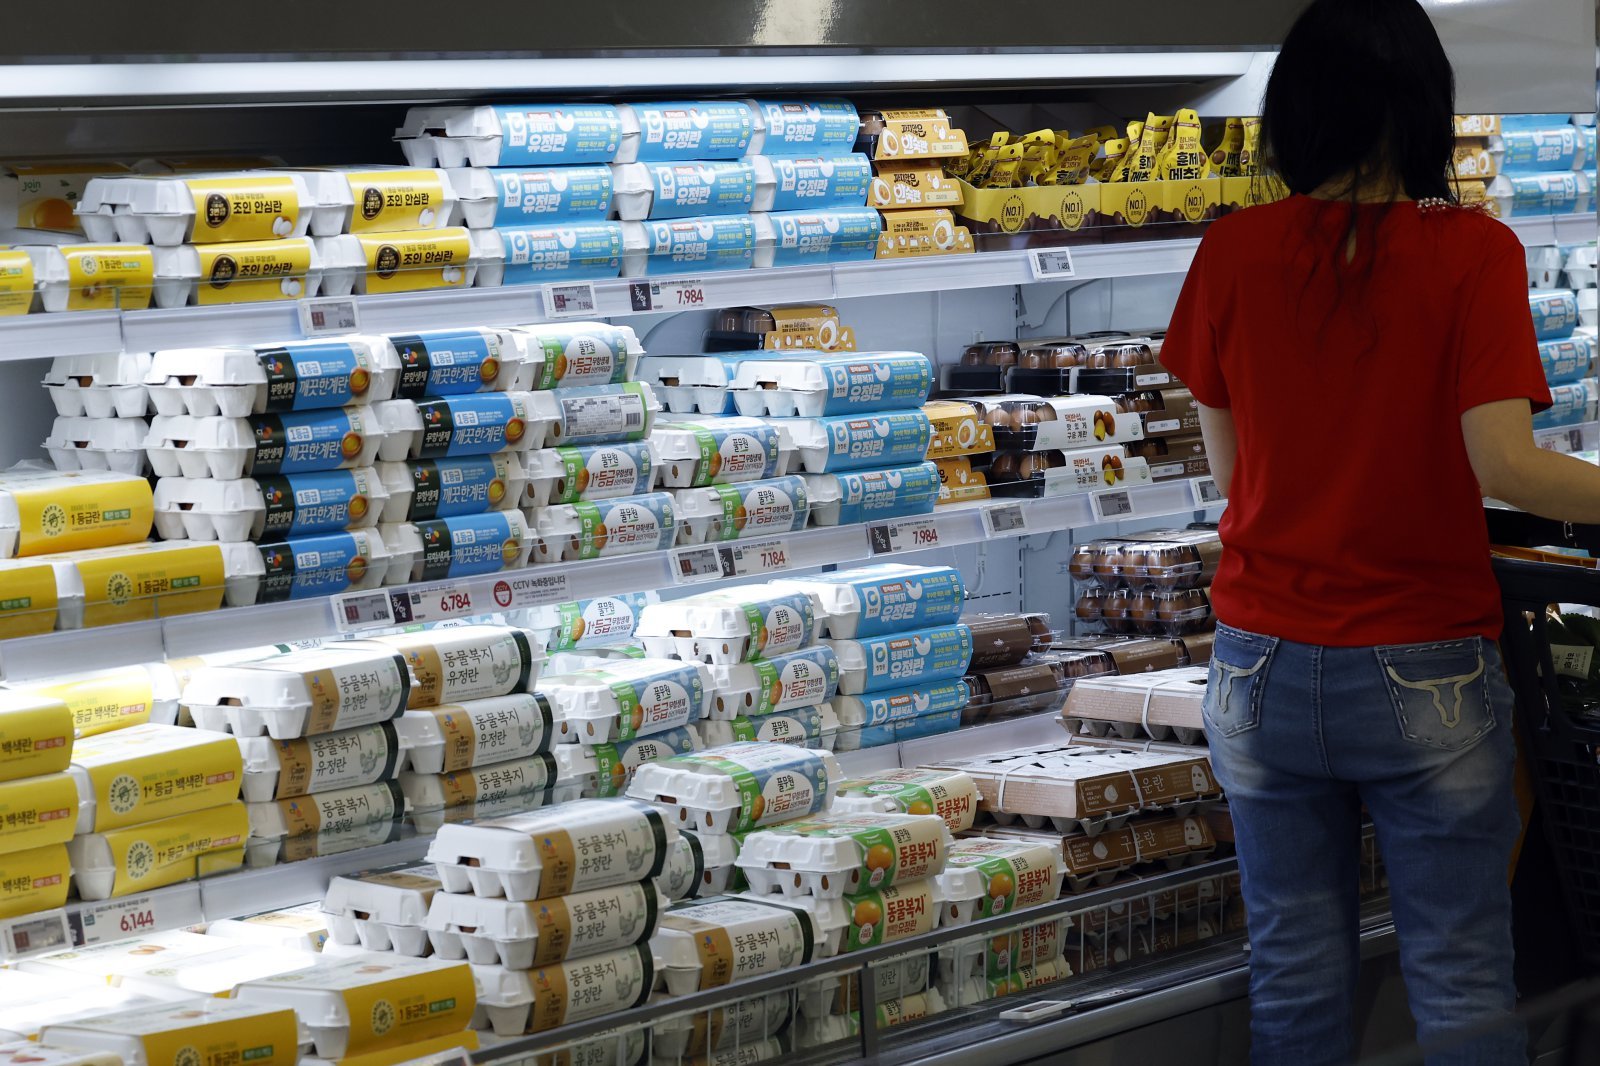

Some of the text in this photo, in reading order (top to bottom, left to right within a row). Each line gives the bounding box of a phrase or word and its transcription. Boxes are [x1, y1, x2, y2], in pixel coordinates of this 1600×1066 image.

[664, 131, 701, 148] 유정란
[784, 125, 816, 142] 유정란
[527, 134, 567, 152] 유정란
[676, 187, 710, 204] 유정란
[796, 180, 828, 197] 유정란
[233, 200, 282, 214] 조인 안심란
[386, 193, 429, 206] 조인 안심란
[523, 195, 561, 212] 유정란
[1065, 202, 1080, 212] NO.1
[1130, 200, 1143, 210] NO.1
[1188, 196, 1202, 206] NO.1
[1006, 206, 1020, 216] NO.1
[404, 251, 453, 265] 조인 안심란
[240, 263, 292, 276] 조인 안심란
[676, 289, 704, 304] 7,984
[578, 340, 595, 355] 풀무원
[433, 352, 452, 364] 1등급
[568, 357, 592, 374] 1+등급
[300, 364, 319, 374] 1등급
[403, 371, 427, 382] 무항생제
[431, 366, 479, 384] 깨끗한계란
[271, 382, 295, 395] 무항생제
[299, 376, 348, 396] 깨끗한계란
[849, 384, 884, 402] 유정란
[457, 412, 476, 424] 1등급
[290, 428, 310, 440] 1등급
[426, 431, 450, 443] 무항생제
[455, 426, 504, 445] 깨끗한계란
[257, 447, 283, 459] 무항생제
[288, 441, 340, 461] 깨끗한계란
[732, 438, 749, 452] 풀무원
[850, 441, 884, 458] 유정란
[601, 452, 618, 468] 풀무원
[723, 454, 746, 472] 1+등급
[444, 471, 462, 483] 1등급
[591, 470, 615, 488] 1+등급
[299, 492, 318, 504] 1등급
[416, 489, 439, 502] 무항생제
[443, 484, 488, 504] 깨끗한계란
[758, 490, 775, 505] 풀무원
[268, 511, 292, 523] 무항생제
[297, 503, 348, 525] 깨끗한계란
[620, 507, 638, 523] 풀무원
[749, 507, 772, 524] 1+등급
[455, 531, 474, 544] 1등급
[610, 524, 636, 543] 1+등급
[912, 529, 938, 545] 7,984
[299, 554, 318, 567] 1등급
[427, 551, 450, 563] 무항생제
[455, 544, 501, 563] 깨끗한계란
[760, 551, 785, 567] 7,184
[268, 575, 291, 586] 무항생제
[513, 575, 565, 590] CCTV 녹화중입니다
[441, 593, 470, 612] 6,784
[598, 601, 615, 616] 풀무원
[775, 609, 790, 625] 풀무원
[881, 602, 917, 622] 유정란
[586, 616, 611, 634] 1+등급
[769, 626, 788, 644] 1+등급
[444, 646, 494, 668] 동물복지
[447, 668, 479, 686] 유정란
[793, 663, 809, 678] 풀무원
[890, 658, 924, 679] 유정란
[340, 671, 380, 694] 동물복지
[784, 680, 807, 699] 1+등급
[654, 684, 672, 701] 풀무원
[342, 694, 368, 712] 유정란
[76, 710, 92, 724] 등급
[94, 704, 119, 719] 백색란
[475, 708, 520, 731] 동물복지
[645, 702, 669, 722] 1+등급
[772, 720, 788, 736] 풀무원
[2, 738, 32, 754] 백색란
[314, 735, 362, 758] 동물복지
[478, 732, 507, 749] 유정란
[638, 744, 657, 760] 풀무원
[316, 759, 346, 777] 유정란
[144, 781, 173, 798] 1+등급
[176, 774, 203, 790] 백색란
[479, 767, 524, 790] 동물복지
[777, 775, 794, 792] 풀무원
[478, 789, 507, 807] 유정란
[931, 785, 947, 802] 풀무원
[322, 794, 370, 818] 동물복지
[767, 794, 791, 814] 1+등급
[6, 810, 36, 825] 백색란
[323, 817, 353, 836] 유정란
[578, 830, 628, 855] 동물복지
[894, 828, 911, 845] 풀무원
[158, 838, 211, 863] 1+등급 백색란
[899, 840, 937, 868] 동물복지
[580, 857, 612, 874] 유정란
[909, 864, 928, 878] 유정란
[1012, 856, 1028, 871] 풀무원
[3, 877, 31, 892] 백색란
[1018, 867, 1050, 894] 동물복지
[1025, 890, 1043, 905] 유정란
[573, 896, 621, 922] 동물복지
[886, 896, 924, 923] 동물복지
[120, 910, 154, 932] 6,144
[898, 920, 916, 934] 유정란
[575, 922, 606, 942] 유정란
[735, 928, 781, 953] 동물복지
[737, 952, 766, 971] 유정란
[570, 960, 618, 984] 동물복지
[572, 988, 602, 1006] 유정란
